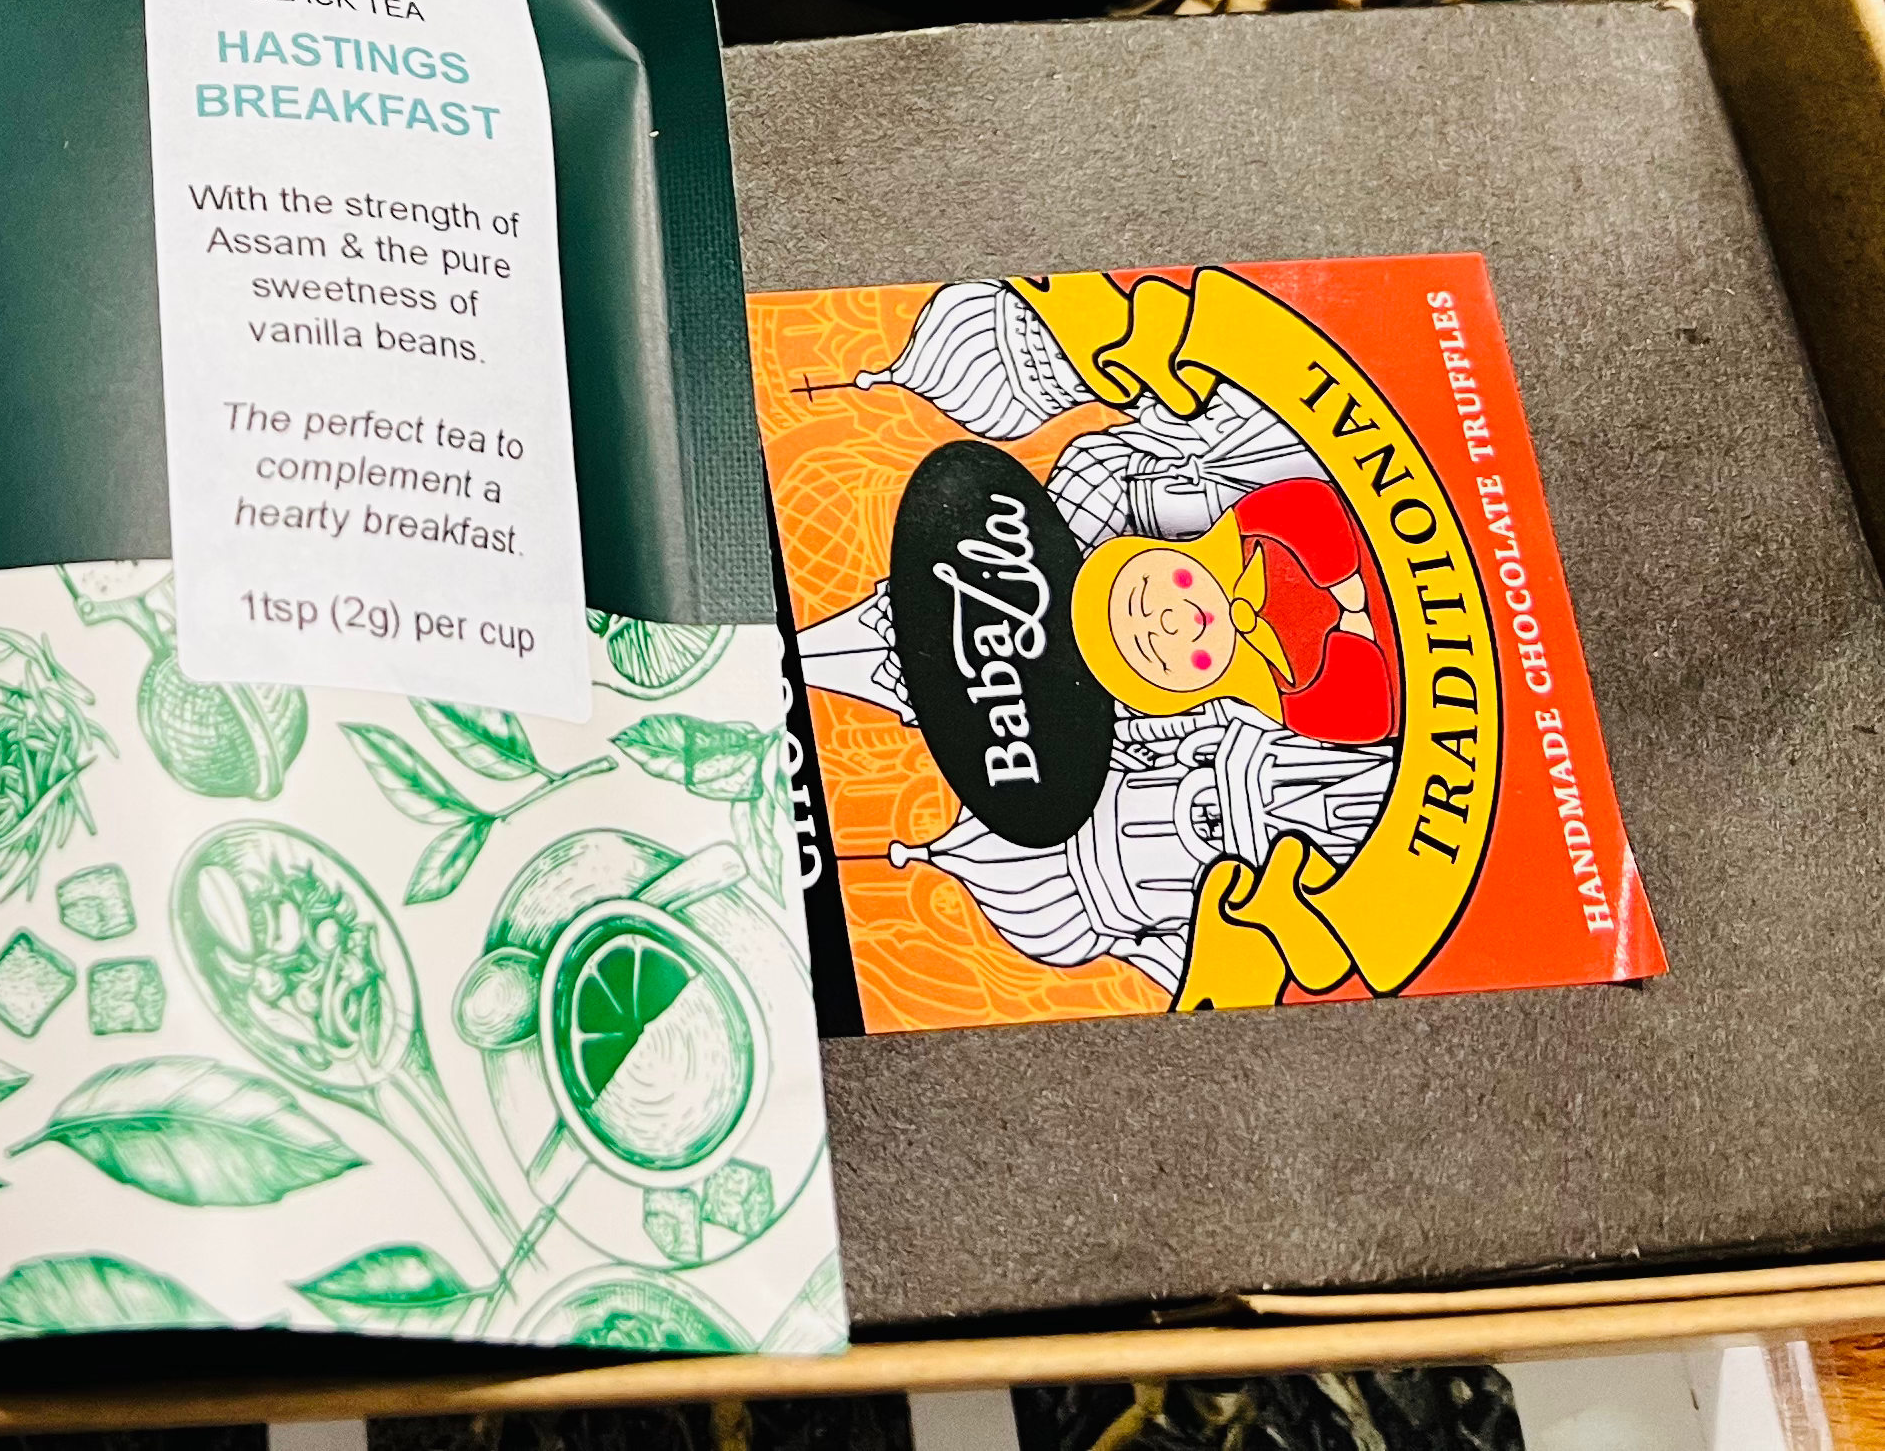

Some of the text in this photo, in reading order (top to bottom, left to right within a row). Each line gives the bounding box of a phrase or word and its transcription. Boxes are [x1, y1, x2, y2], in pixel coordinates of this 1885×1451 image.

[217, 30, 470, 84] HASTINGS
[195, 83, 501, 140] BREAKFAST
[188, 184, 520, 238] With the strength of
[206, 226, 512, 279] Assam & the pure
[252, 276, 480, 317] sweetness of
[248, 317, 485, 363] vanilla beans.
[223, 401, 525, 460] The perfect tea to
[256, 456, 502, 504] complement a
[234, 496, 524, 557] hearty breakfast.
[240, 589, 535, 658] 1tsp (2g) per cup
[1299, 359, 1480, 866] TRADITIONAL
[1426, 289, 1614, 934] HANDMADE CHOCOLATE TRUFFLES
